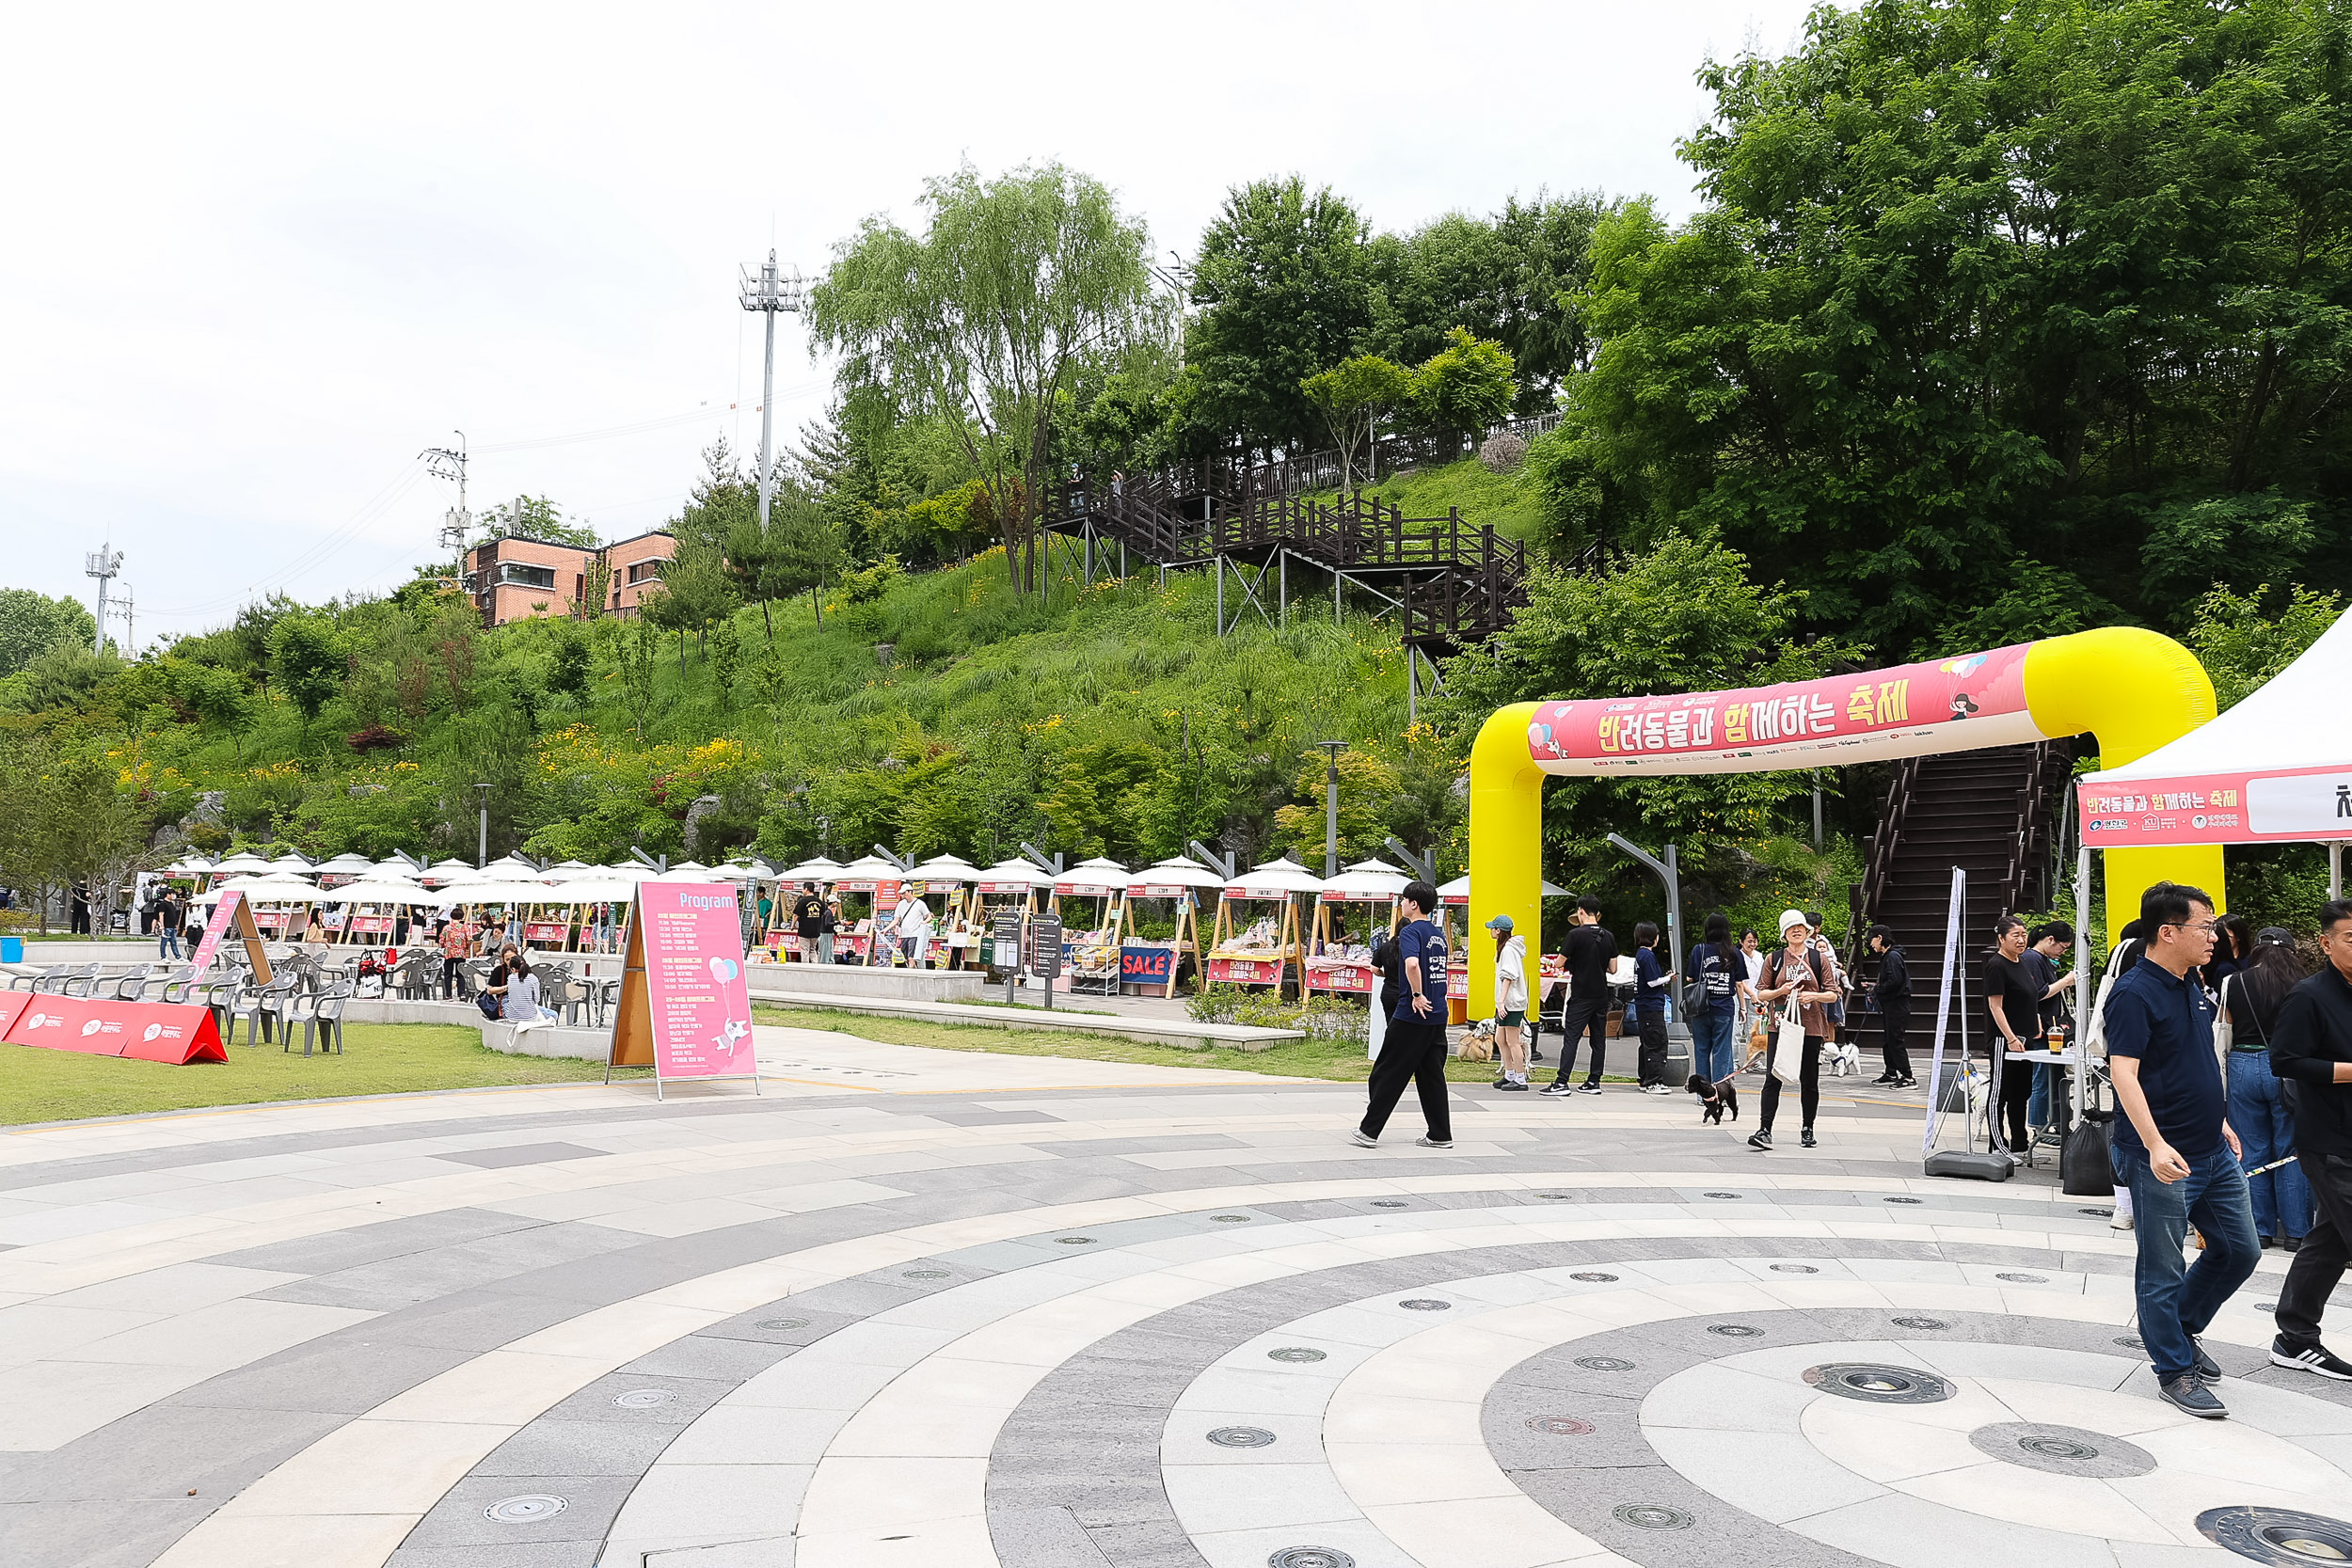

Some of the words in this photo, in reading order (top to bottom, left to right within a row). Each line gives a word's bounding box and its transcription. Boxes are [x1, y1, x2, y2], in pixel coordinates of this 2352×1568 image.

[1598, 706, 1715, 752] 반려동물과
[1724, 693, 1836, 743] 함께하는
[1846, 678, 1909, 726] 축제
[2086, 795, 2149, 814] 반려동물과
[2151, 792, 2206, 811] 함께하는
[2210, 789, 2237, 807] 축제
[679, 892, 734, 911] Program
[1122, 955, 1166, 975] SALE
